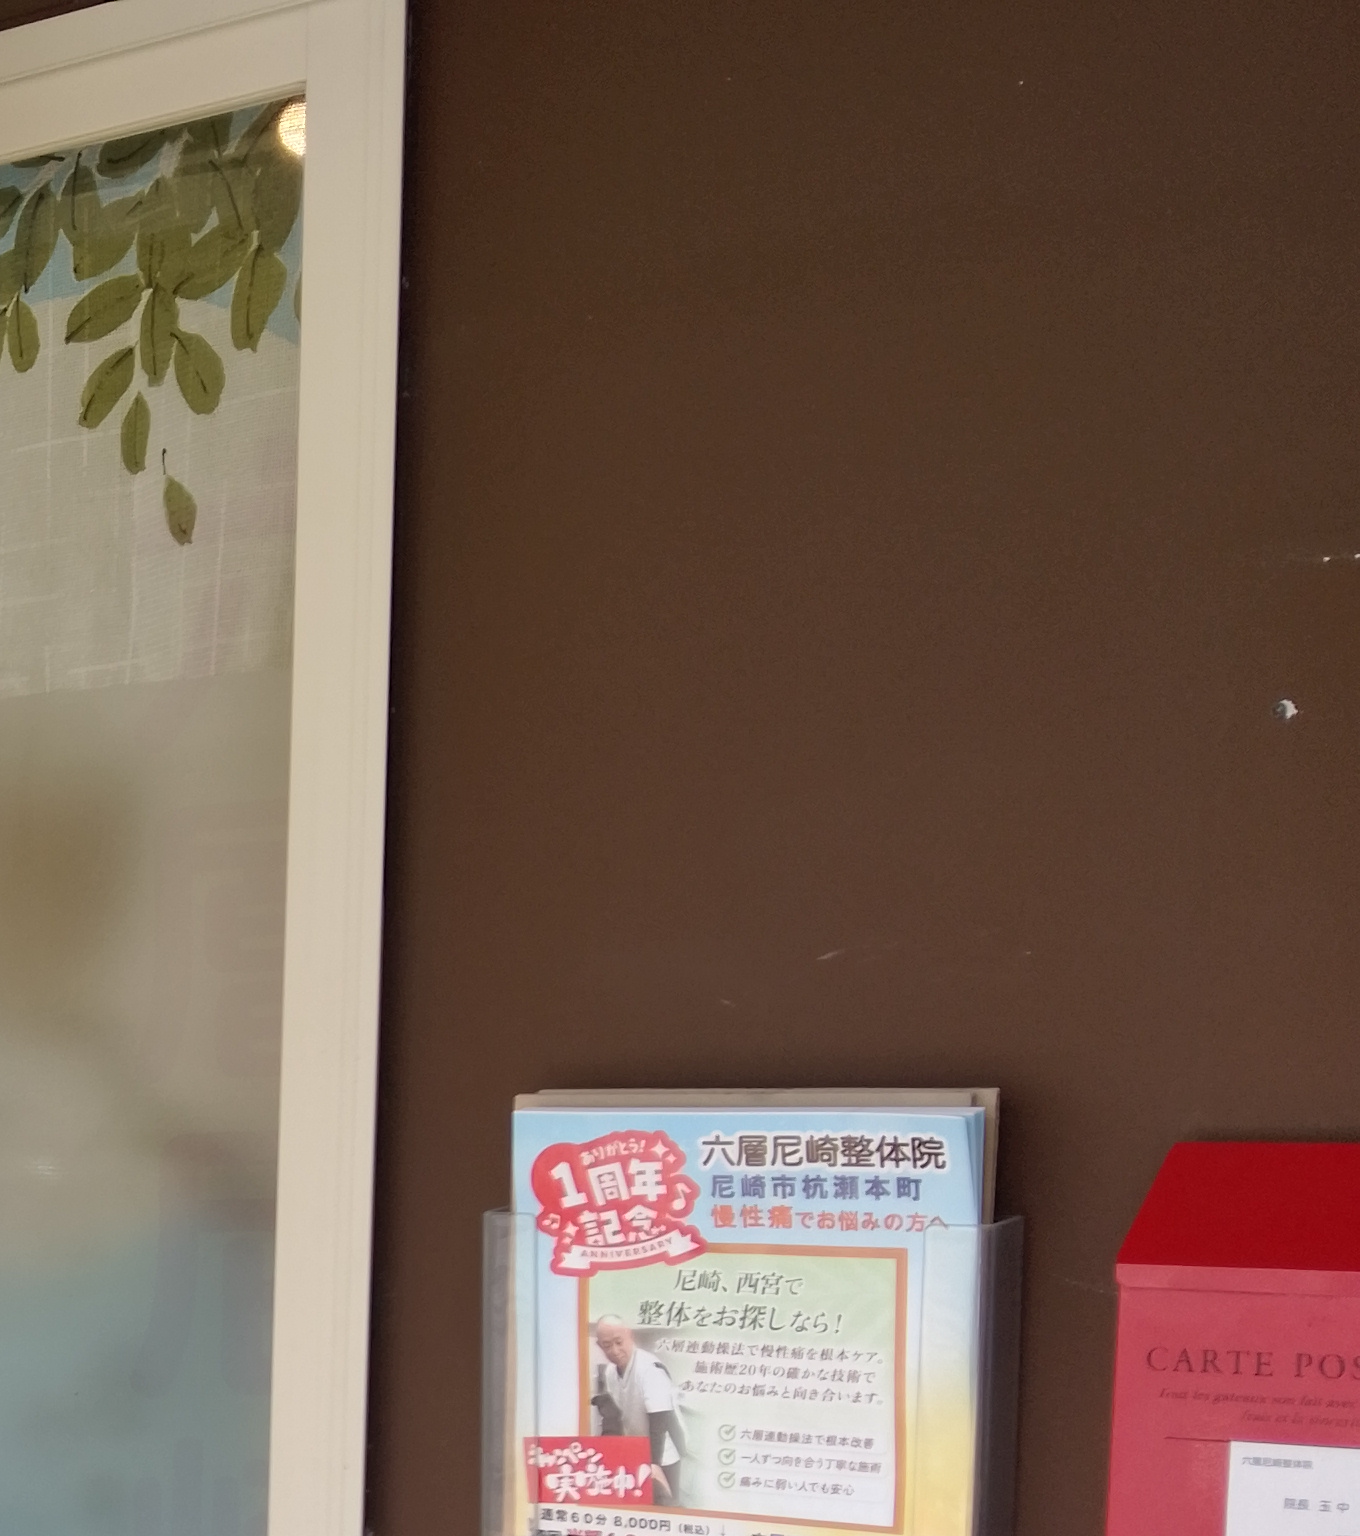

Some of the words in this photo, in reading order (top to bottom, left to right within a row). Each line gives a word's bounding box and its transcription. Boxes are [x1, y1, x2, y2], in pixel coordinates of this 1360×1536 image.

[701, 1134, 947, 1170] 六層尼崎整体院
[549, 1157, 668, 1209] 1周年
[711, 1175, 922, 1201] 尼崎市杭瀬本町
[578, 1204, 667, 1248] 記念
[711, 1204, 949, 1232] 慢性痛でお悩みの方へ
[581, 1236, 673, 1258] ANNIVERSARY
[674, 1269, 804, 1296] 尼崎、西宮で
[1146, 1346, 1274, 1377] CARTE
[613, 1515, 672, 1532] 8,000円
